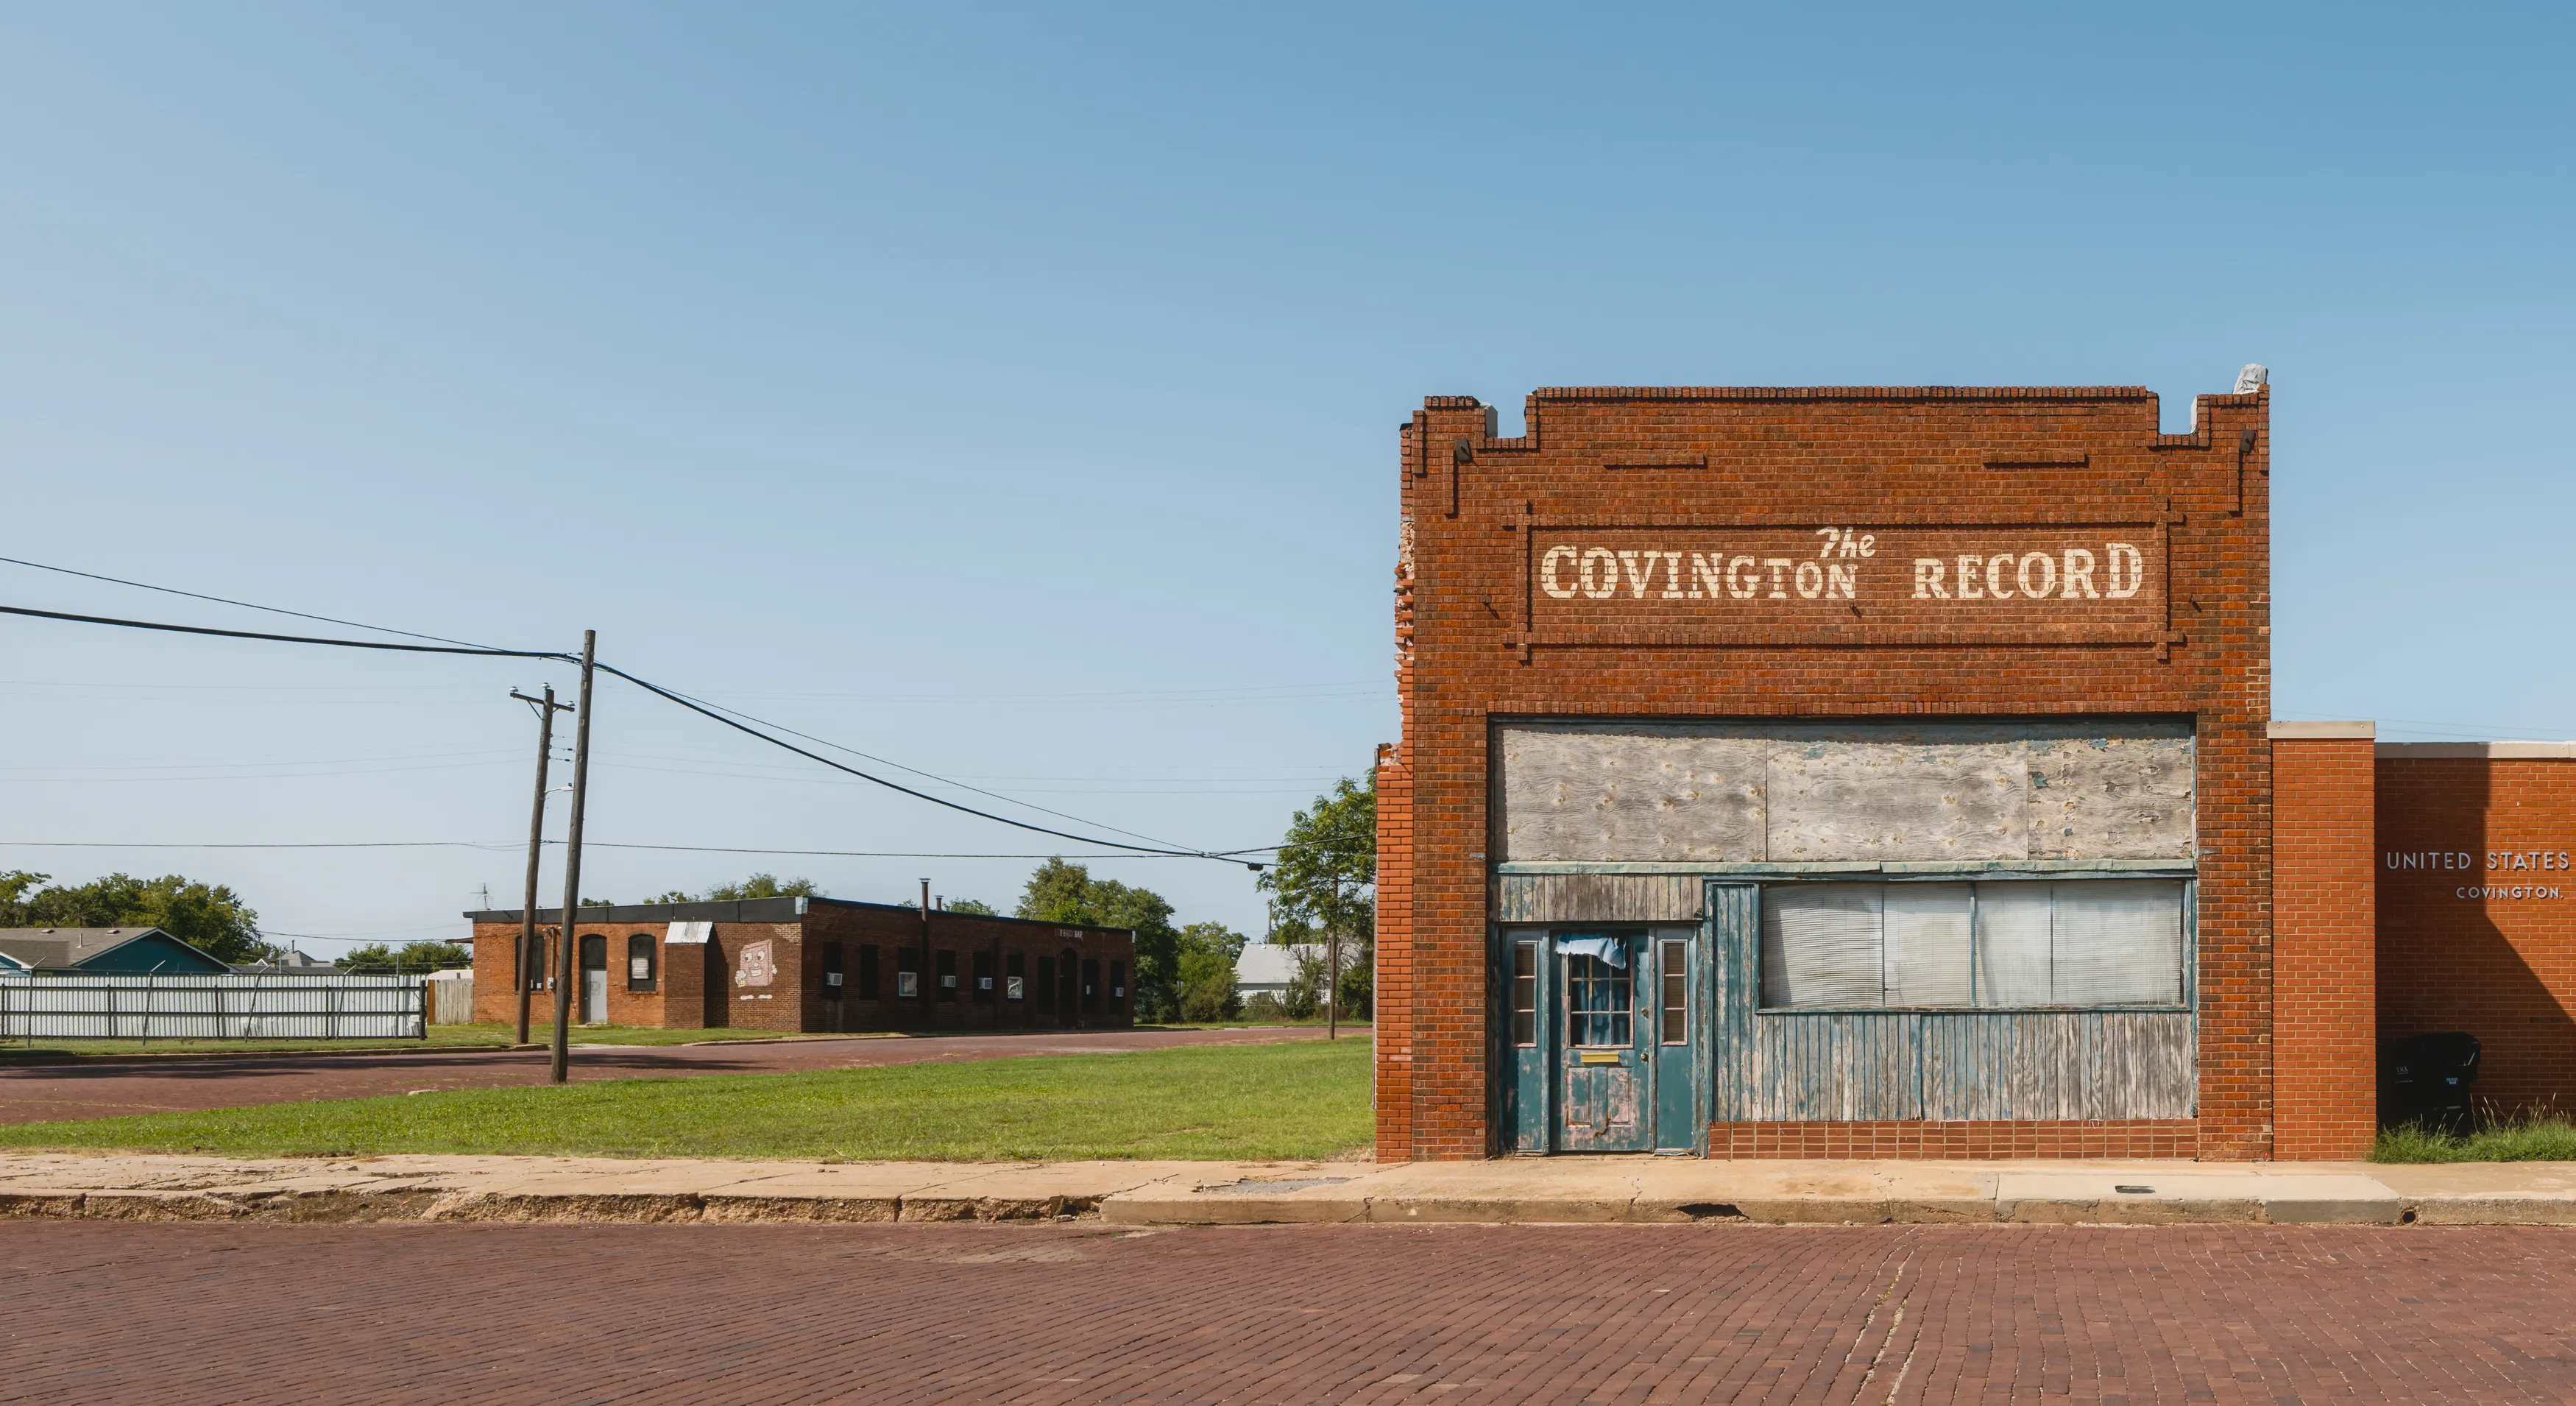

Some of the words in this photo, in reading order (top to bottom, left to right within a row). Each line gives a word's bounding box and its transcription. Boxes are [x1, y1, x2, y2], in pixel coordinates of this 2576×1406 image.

[1816, 526, 1876, 558] The
[1540, 545, 1859, 599] COVINGTON
[1911, 543, 2143, 599] RECORD
[2387, 852, 2471, 869] UNITED
[2486, 851, 2569, 870] STATES
[2456, 886, 2564, 900] COVINGTON.
